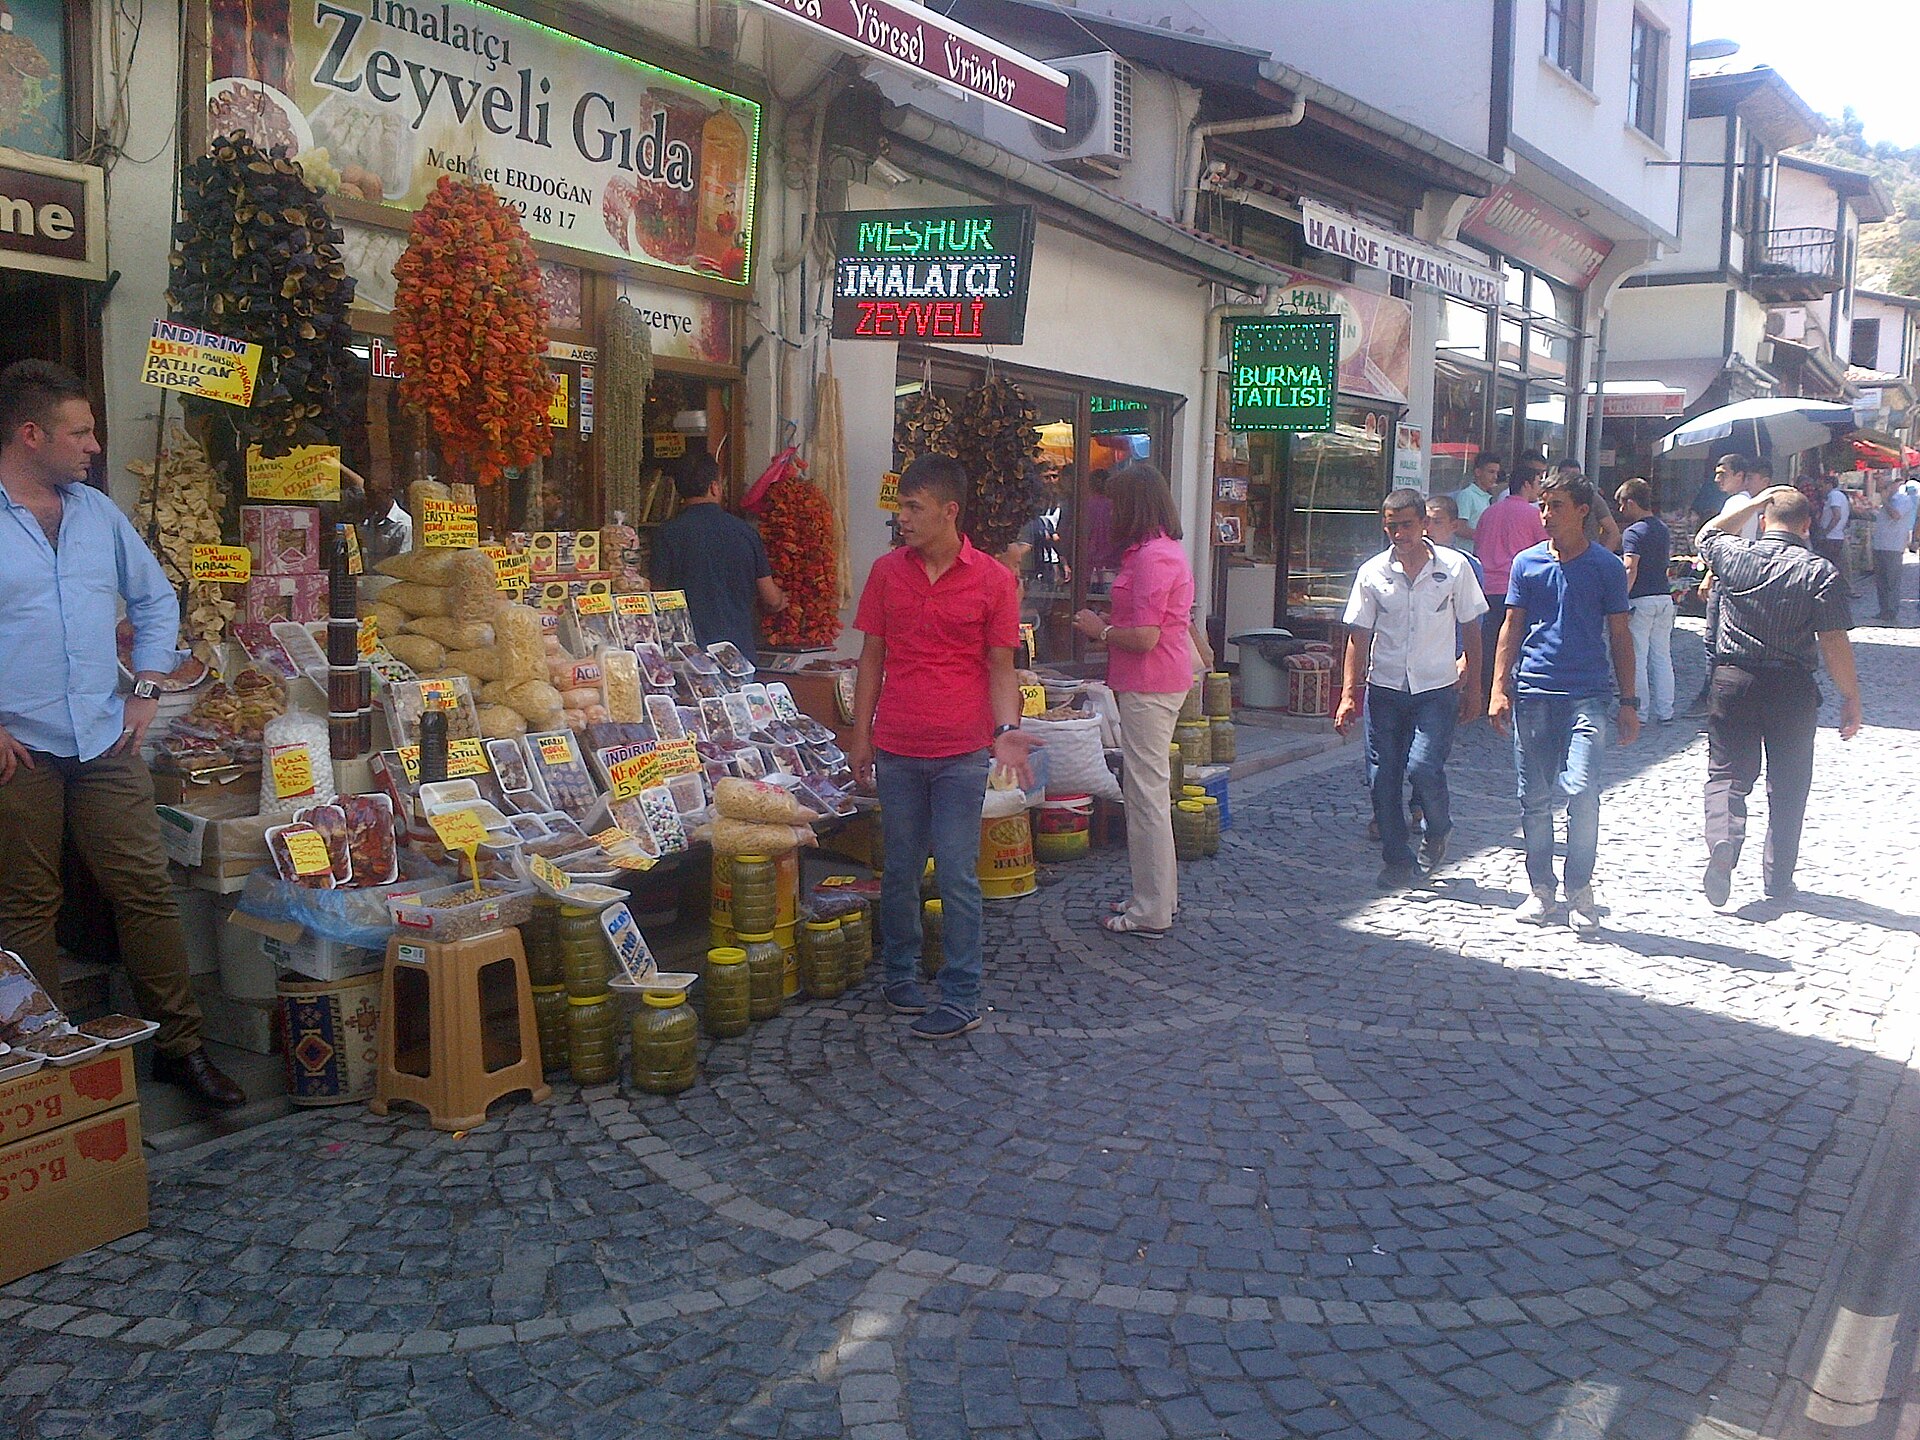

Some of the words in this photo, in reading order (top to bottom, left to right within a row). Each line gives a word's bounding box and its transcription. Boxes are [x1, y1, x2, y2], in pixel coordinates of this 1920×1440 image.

[852, 0, 925, 65] Yöresel
[943, 34, 1018, 102] Ürünler
[314, 2, 552, 149] Zeyveli
[572, 92, 694, 188] Gıda
[427, 148, 500, 183] Mehet
[506, 167, 592, 207] ERDOĞAN
[532, 204, 553, 225] 48
[559, 210, 577, 230] 17
[1308, 218, 1379, 267] HALİSE
[1385, 245, 1464, 295] TEYZENİN
[1467, 273, 1502, 304] YERİ
[855, 296, 985, 337] ZEYVELİ
[1233, 387, 1327, 407] TATLISI
[1238, 364, 1324, 387] BURMA
